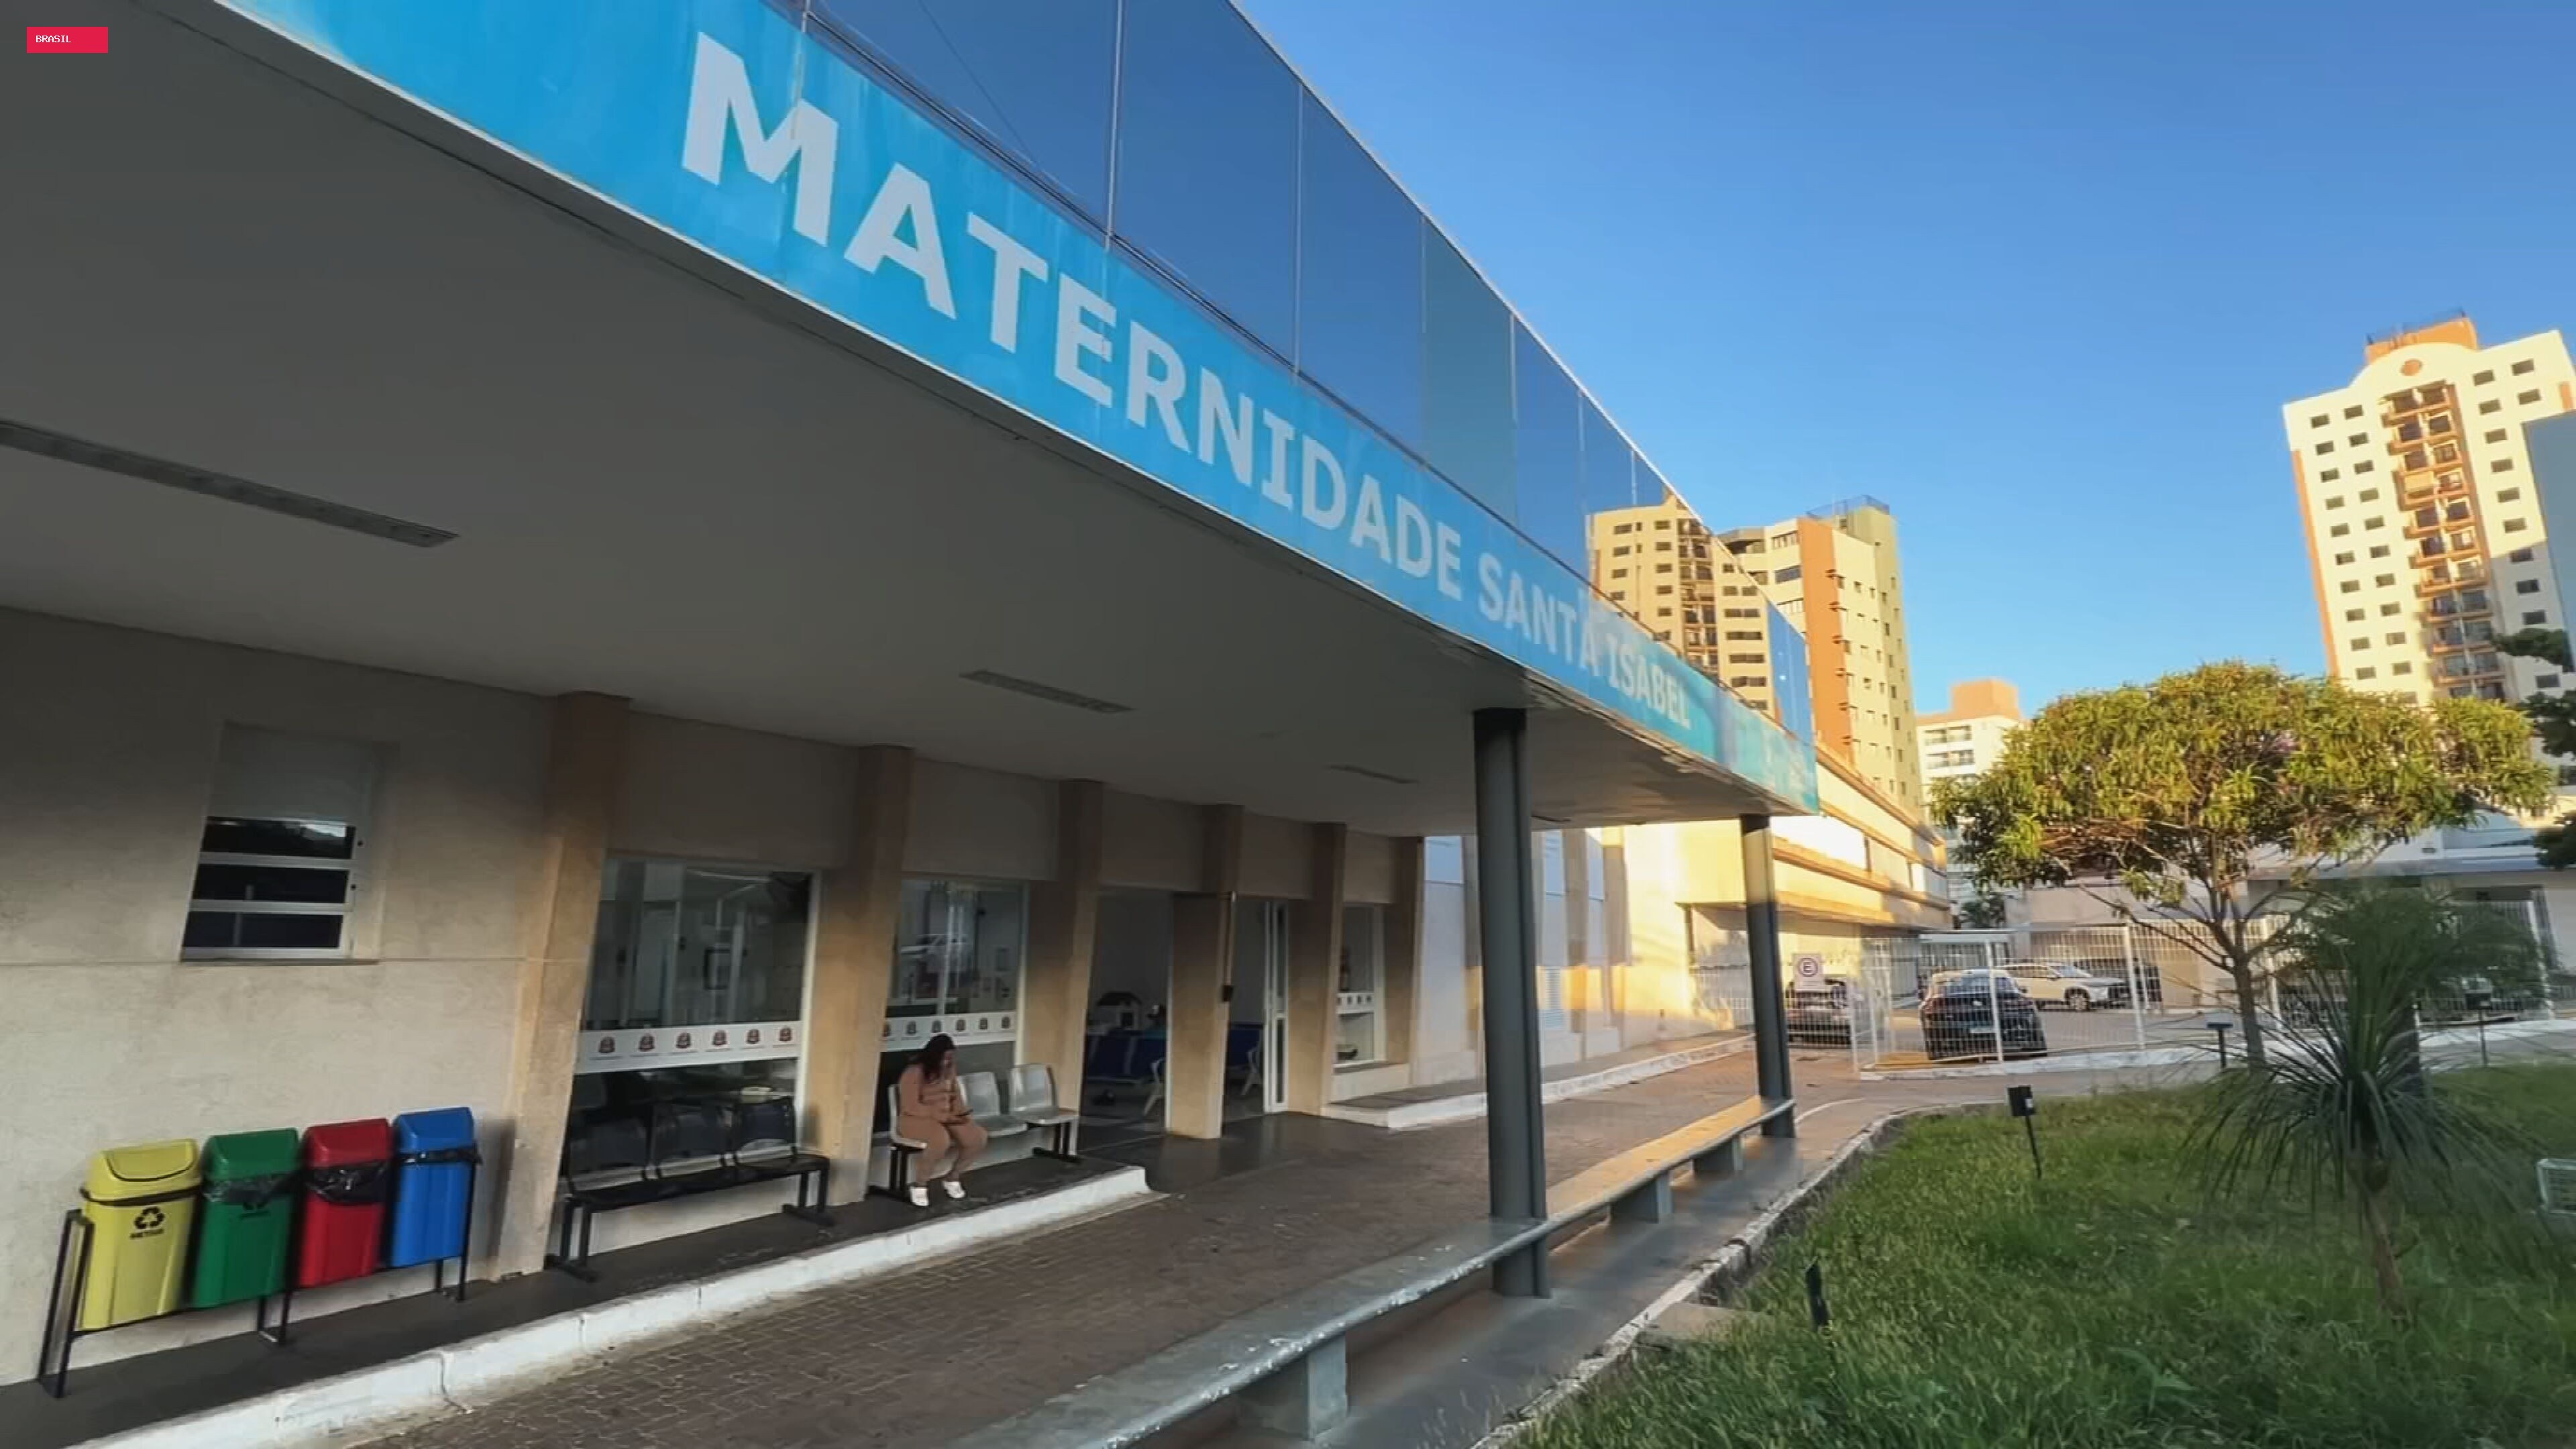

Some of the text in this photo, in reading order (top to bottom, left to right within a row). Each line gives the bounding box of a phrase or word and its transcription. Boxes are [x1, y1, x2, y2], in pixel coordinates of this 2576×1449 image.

[682, 31, 1691, 730] MATERNIDADE SANTA ISABEL
[1803, 961, 1813, 973] E
